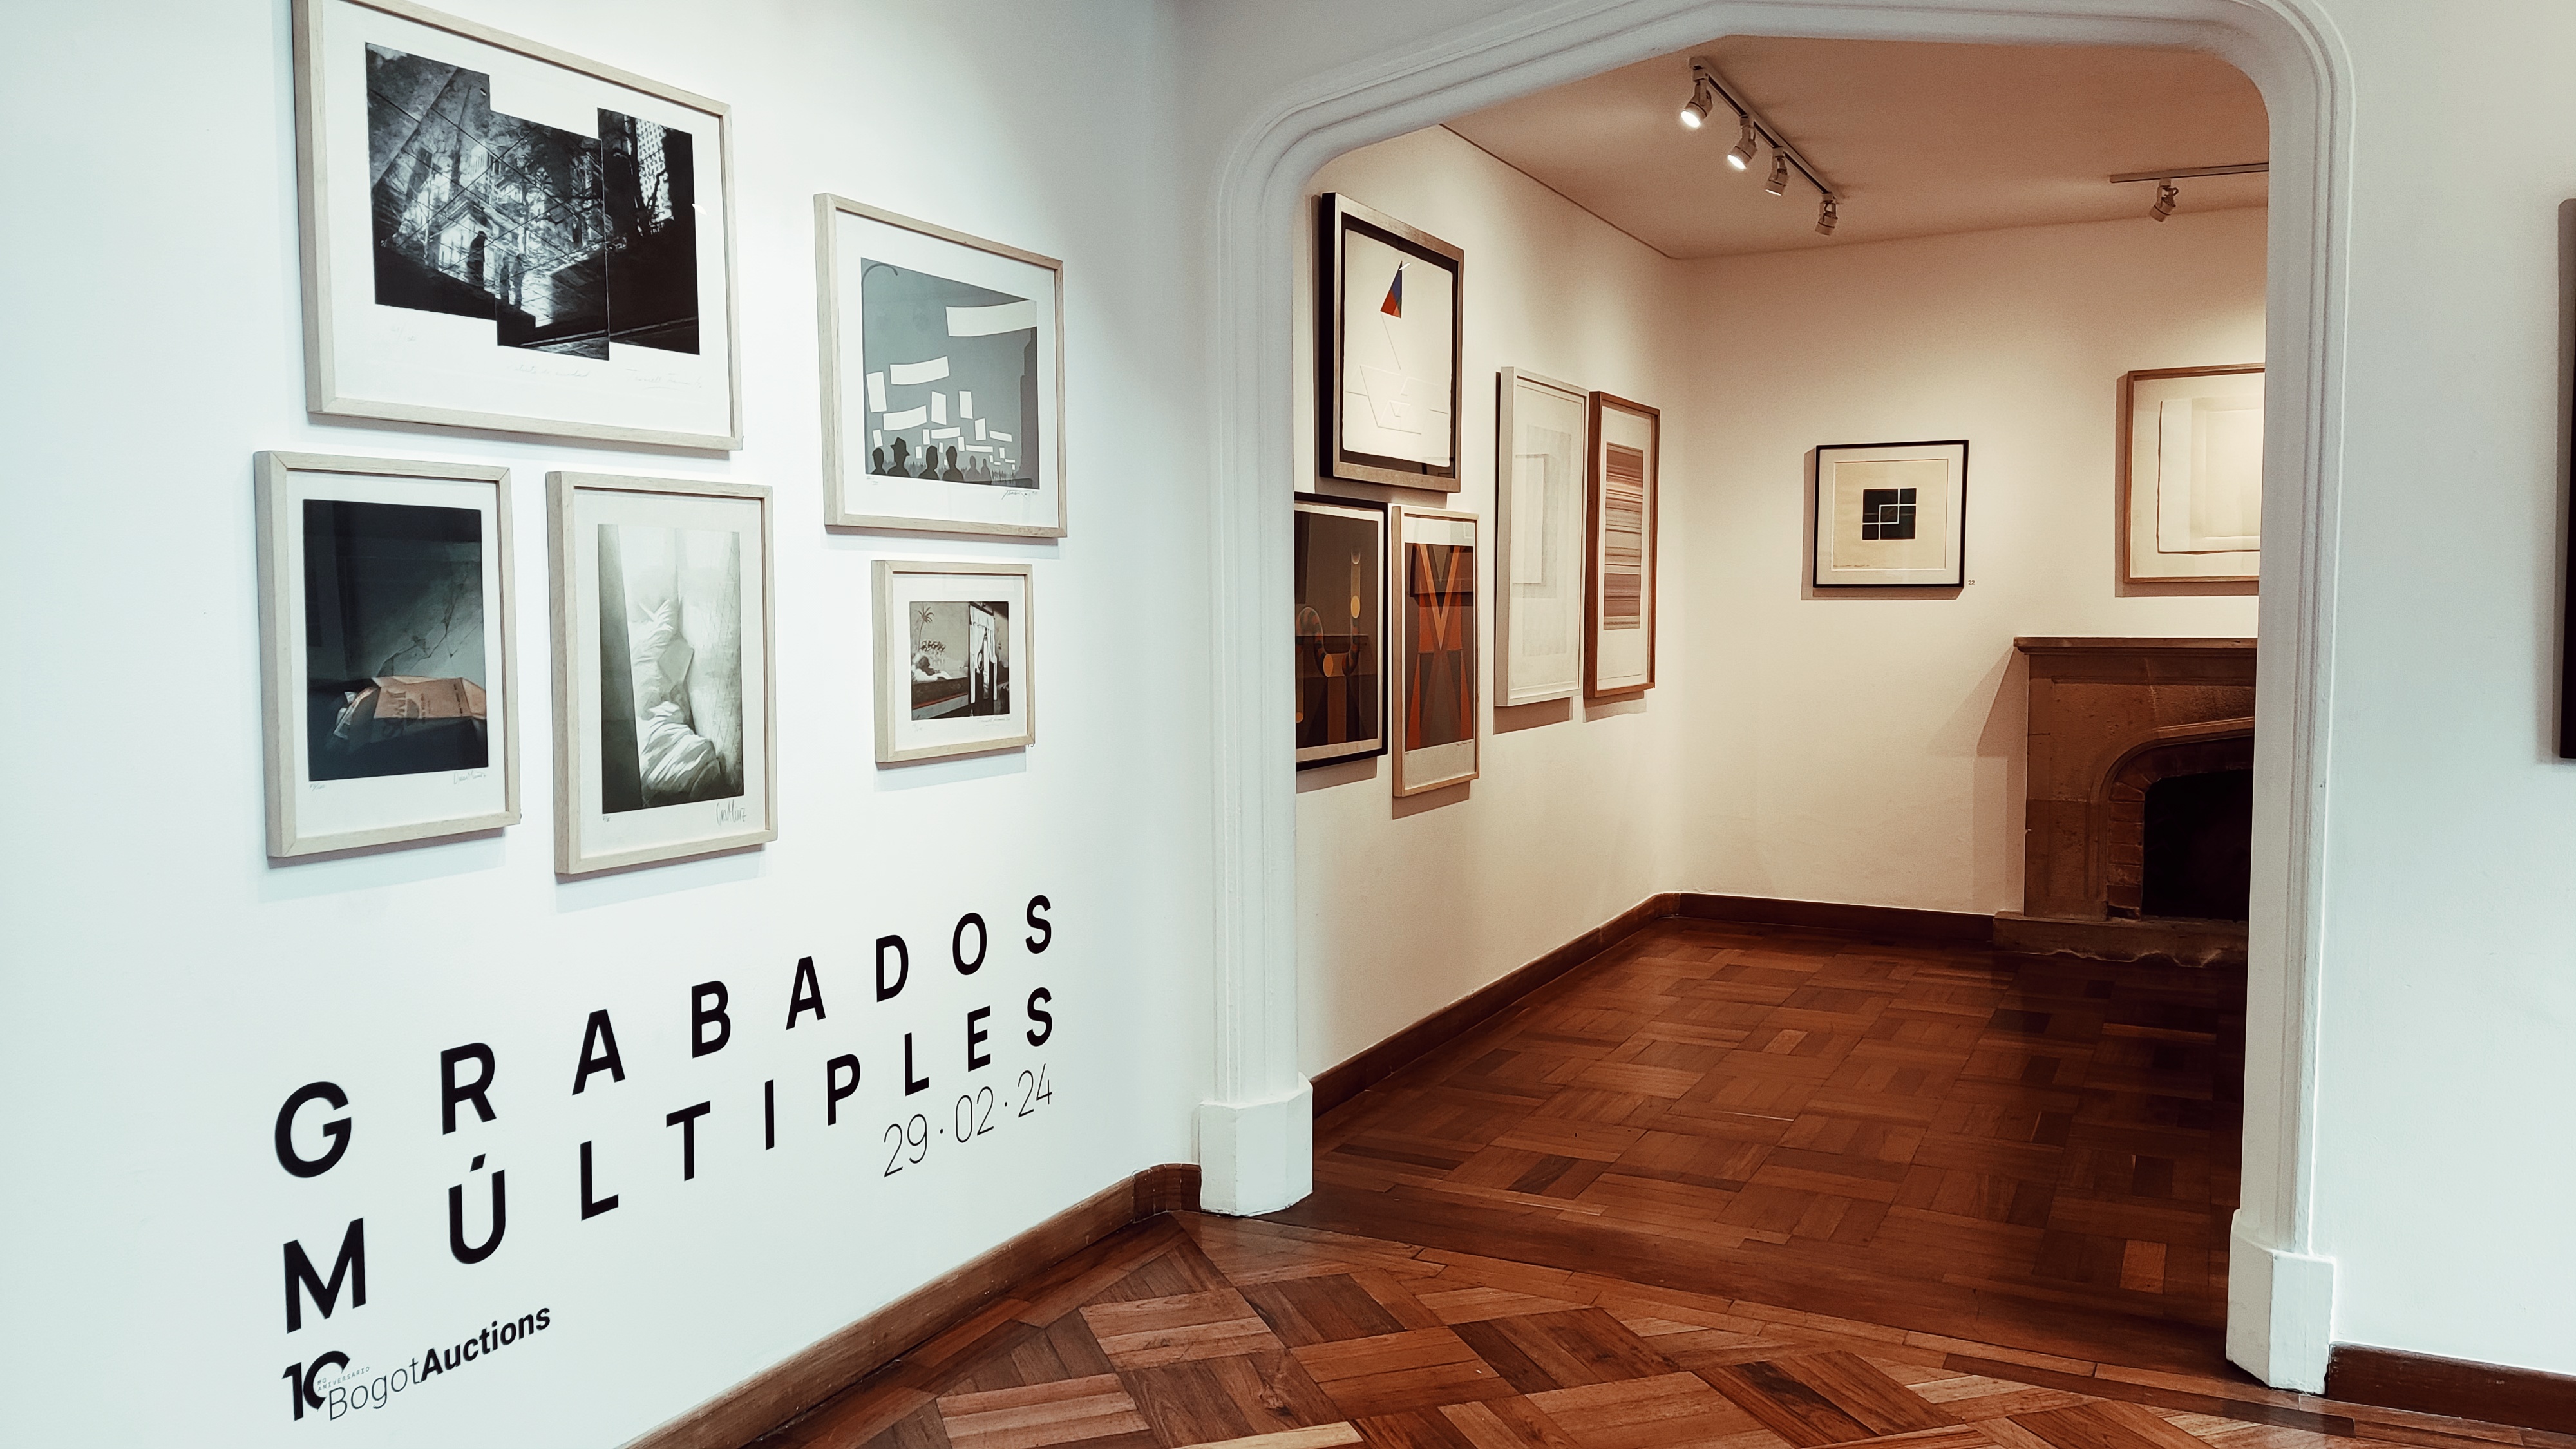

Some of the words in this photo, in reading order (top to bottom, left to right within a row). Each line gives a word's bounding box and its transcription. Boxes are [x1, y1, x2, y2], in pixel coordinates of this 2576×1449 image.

[275, 895, 1052, 1178] GRABADOS
[283, 987, 1052, 1334] MÚLTIPLES
[317, 1366, 370, 1392] ANIVERSARIO
